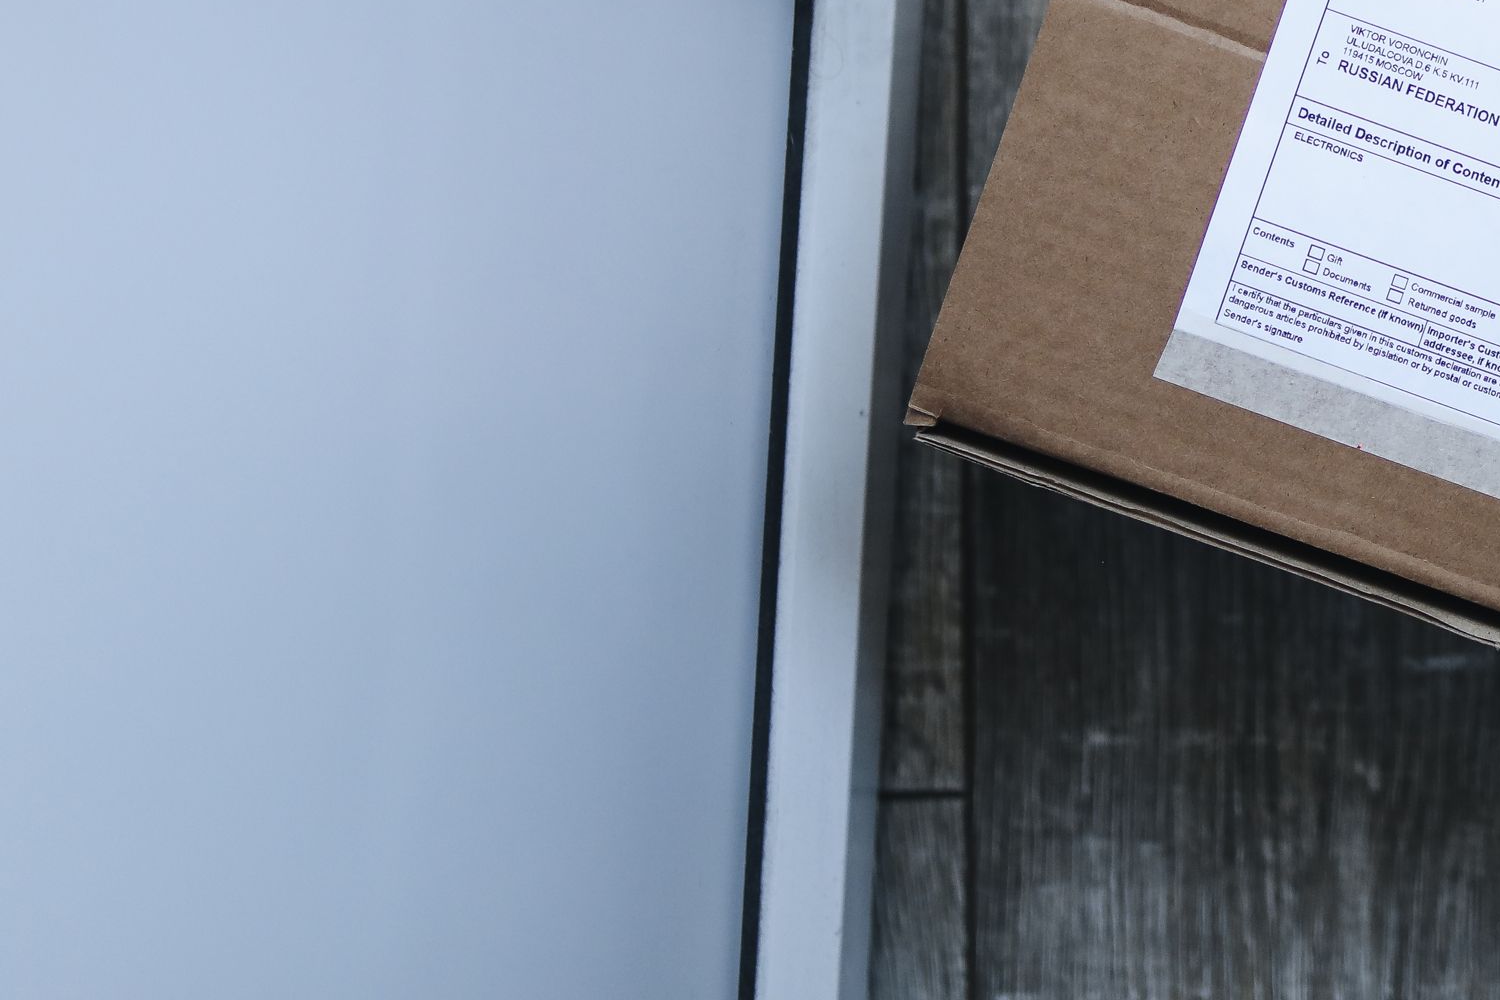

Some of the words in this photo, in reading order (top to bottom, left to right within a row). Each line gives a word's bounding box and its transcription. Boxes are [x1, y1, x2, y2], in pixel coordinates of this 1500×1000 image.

[1316, 51, 1330, 65] To
[1350, 24, 1387, 45] VIKTOR
[1388, 37, 1449, 66] VORONCHIN
[1343, 46, 1375, 64] 119415
[1374, 57, 1424, 81] MOSCOW
[1337, 58, 1404, 92] RUSSIAN
[1405, 83, 1500, 127] FEDERATION
[1293, 130, 1364, 163] ELECTRONICS
[1297, 106, 1353, 136] Detailed
[1354, 126, 1431, 164] Description
[1434, 158, 1451, 170] of
[1252, 226, 1295, 248] Contents
[1326, 253, 1343, 266] Gift
[1240, 259, 1283, 282] Sender's
[1284, 275, 1327, 298] Customs
[1327, 290, 1376, 315] Reference
[1377, 308, 1389, 319] (if
[1388, 312, 1424, 334] known)
[1322, 267, 1372, 292] Documents
[1407, 296, 1448, 319] Returned
[1448, 313, 1477, 329] goods
[1410, 282, 1464, 308] Commercial
[1464, 303, 1496, 320] sample
[1223, 308, 1262, 329] Sender's
[1263, 324, 1303, 344] signature
[1228, 295, 1274, 317] dangerous
[1275, 312, 1307, 329] articles
[1306, 324, 1352, 345] prohibited
[1352, 338, 1364, 351] by
[1364, 342, 1409, 366] legislation
[1410, 360, 1421, 369] or
[1420, 362, 1433, 375] by
[1432, 369, 1461, 384] postal
[1461, 379, 1472, 388] or
